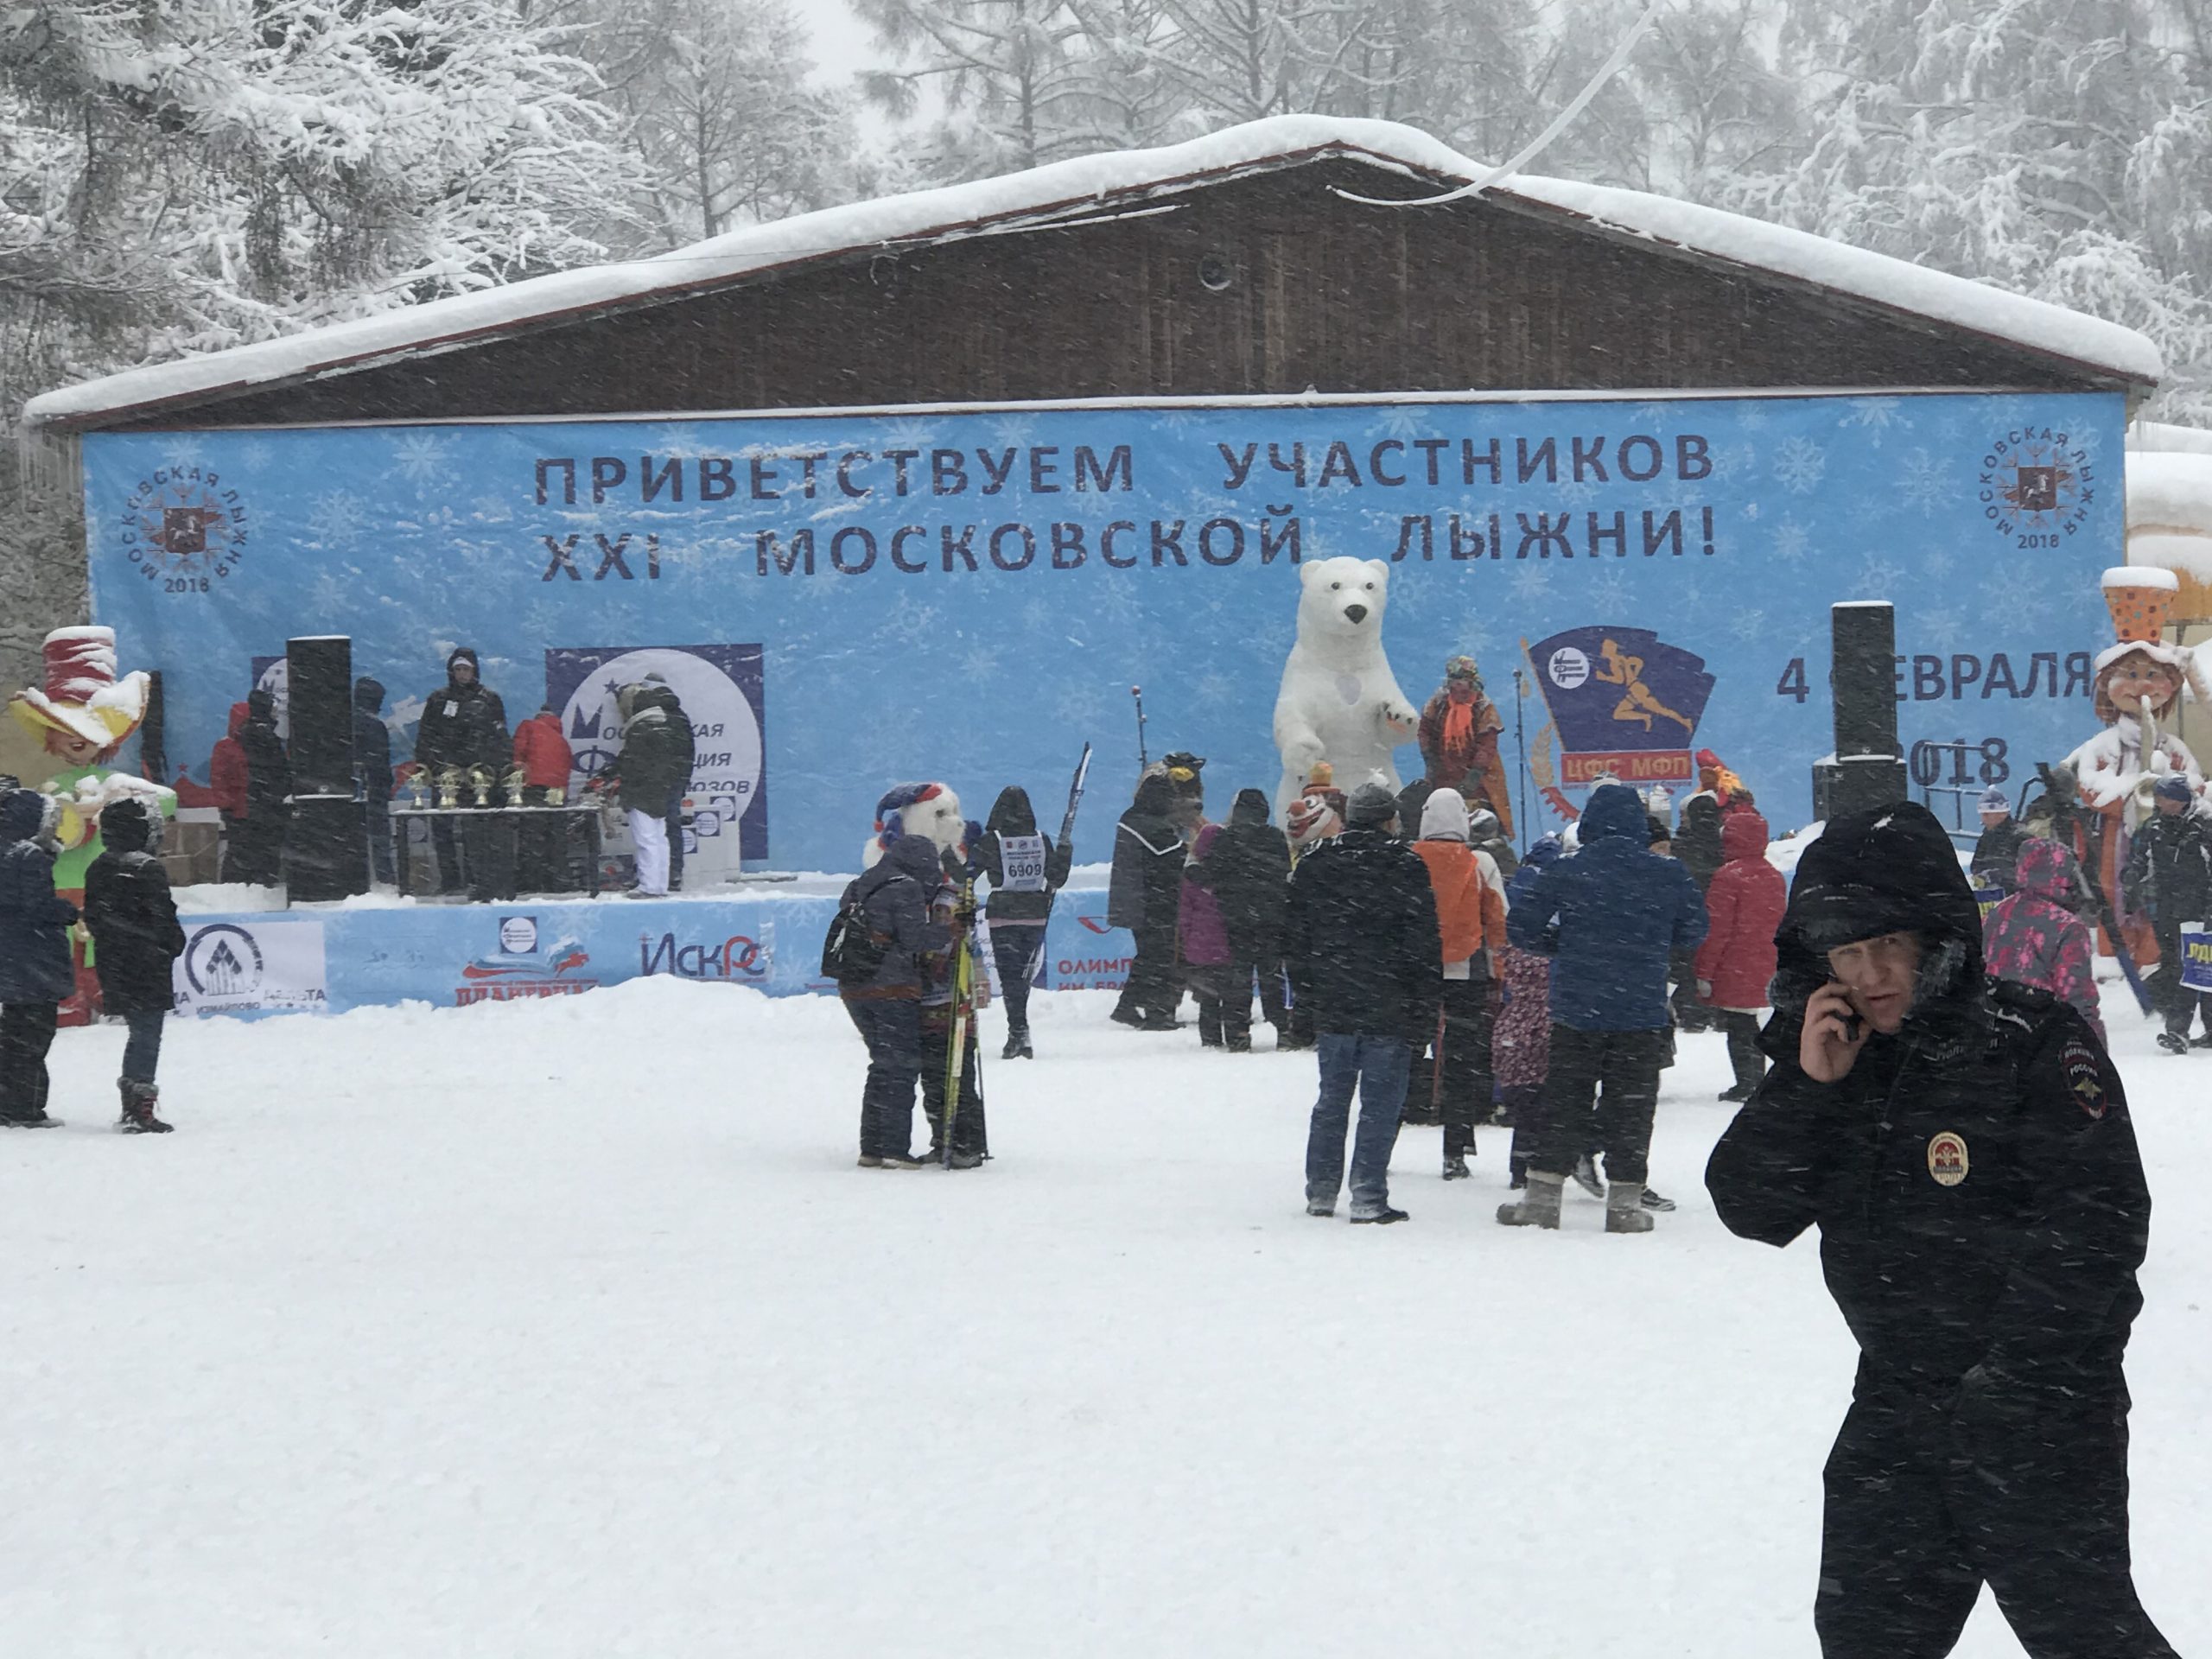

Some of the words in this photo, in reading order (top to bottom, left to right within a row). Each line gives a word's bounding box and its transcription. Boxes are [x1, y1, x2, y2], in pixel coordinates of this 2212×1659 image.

[536, 444, 1134, 505] ПРИВЕТСТВУЕМ
[1217, 435, 1713, 490] УЧАСТНИКОВ
[1979, 426, 2069, 536] МОСКОВСКАЯ
[2063, 449, 2095, 536] ЛЫЖНЯ
[121, 466, 219, 581] МОСКОВСКАЯ
[213, 489, 249, 578] ЛЫЖНЯ
[756, 504, 1301, 575] МОСКОВСКОЙ
[1390, 505, 1715, 562] ЛЫЖНИ!
[2018, 534, 2060, 549] 2018
[164, 578, 210, 593] 2018
[1777, 658, 1809, 703] 4
[1829, 651, 2091, 702] ВРАЛЯ
[1567, 758, 1621, 780] ЦФС
[1631, 756, 1688, 776] МФП
[1897, 737, 2009, 785] 018
[1008, 863, 1042, 878] 6909
